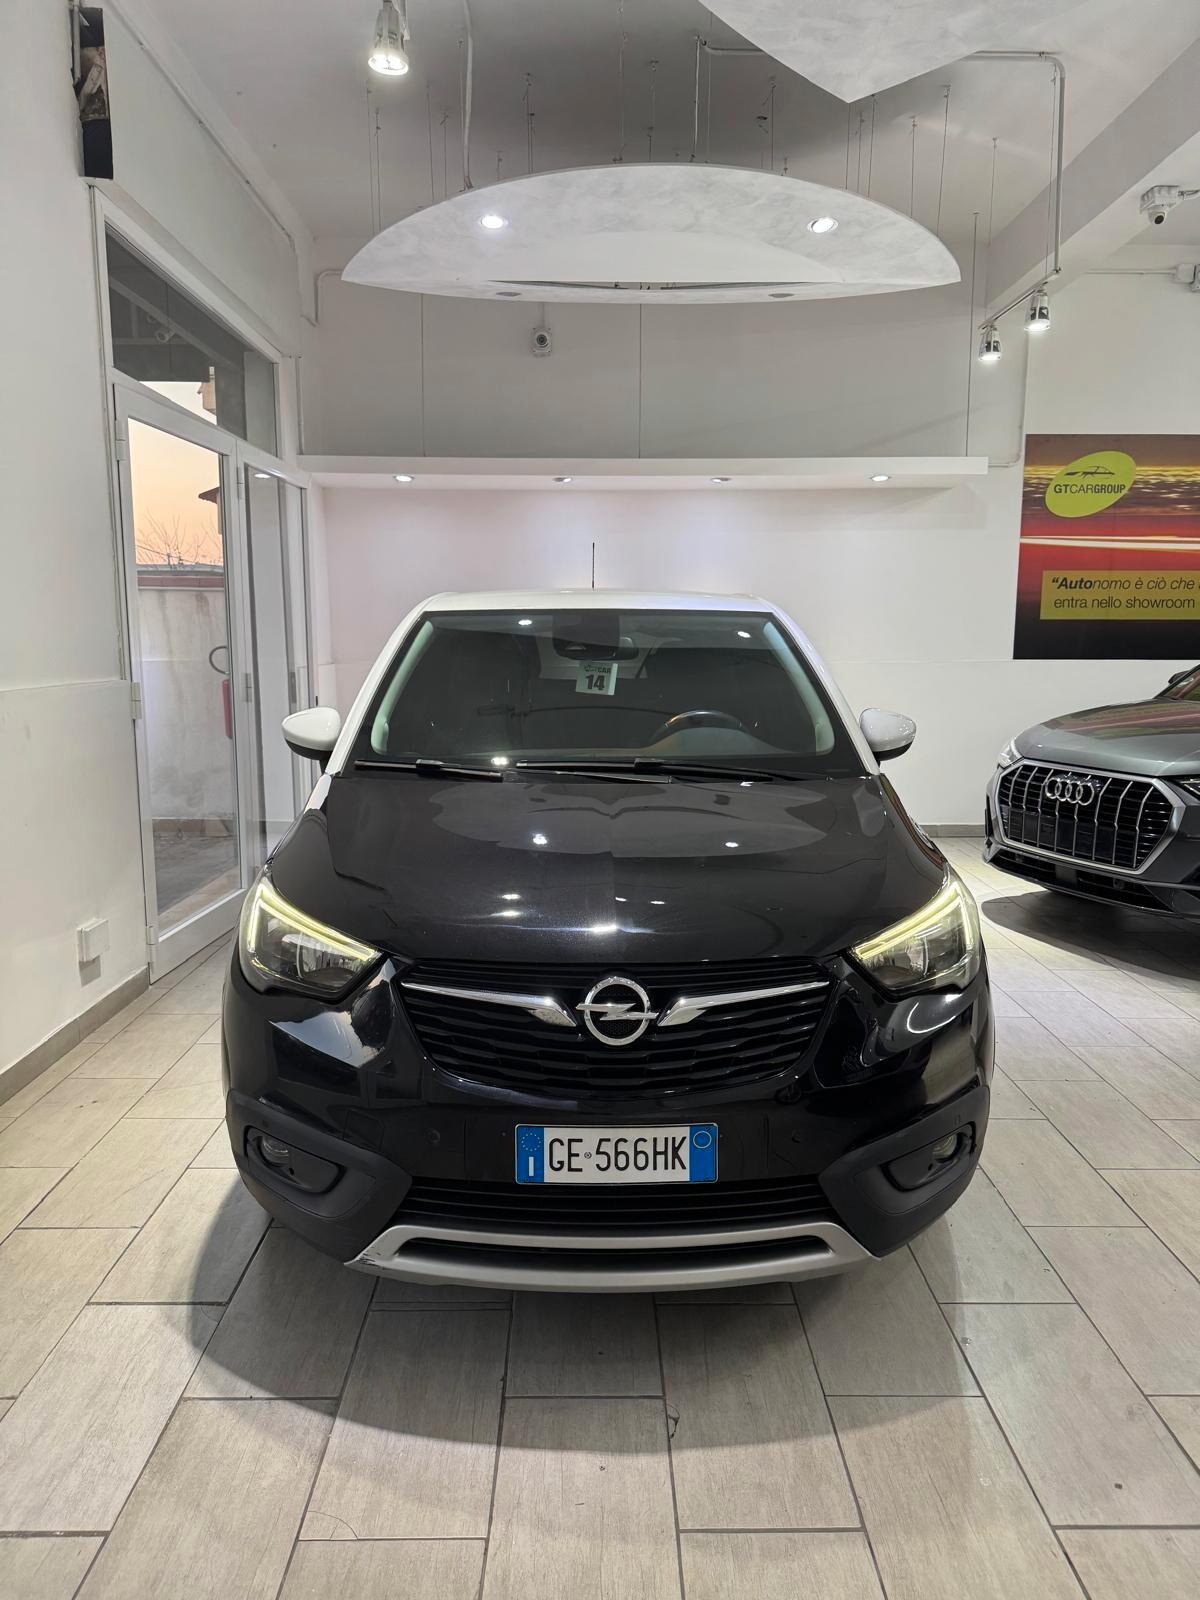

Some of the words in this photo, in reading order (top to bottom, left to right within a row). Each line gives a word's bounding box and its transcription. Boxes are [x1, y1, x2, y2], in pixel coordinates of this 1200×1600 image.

[1053, 483, 1126, 495] GTCARGROUP
[1135, 577, 1143, 590] è
[1146, 577, 1167, 590] ciò
[1170, 577, 1195, 590] che
[1054, 597, 1088, 609] entra
[1091, 596, 1122, 609] nello
[1125, 596, 1195, 609] showroom
[585, 674, 605, 690] 14
